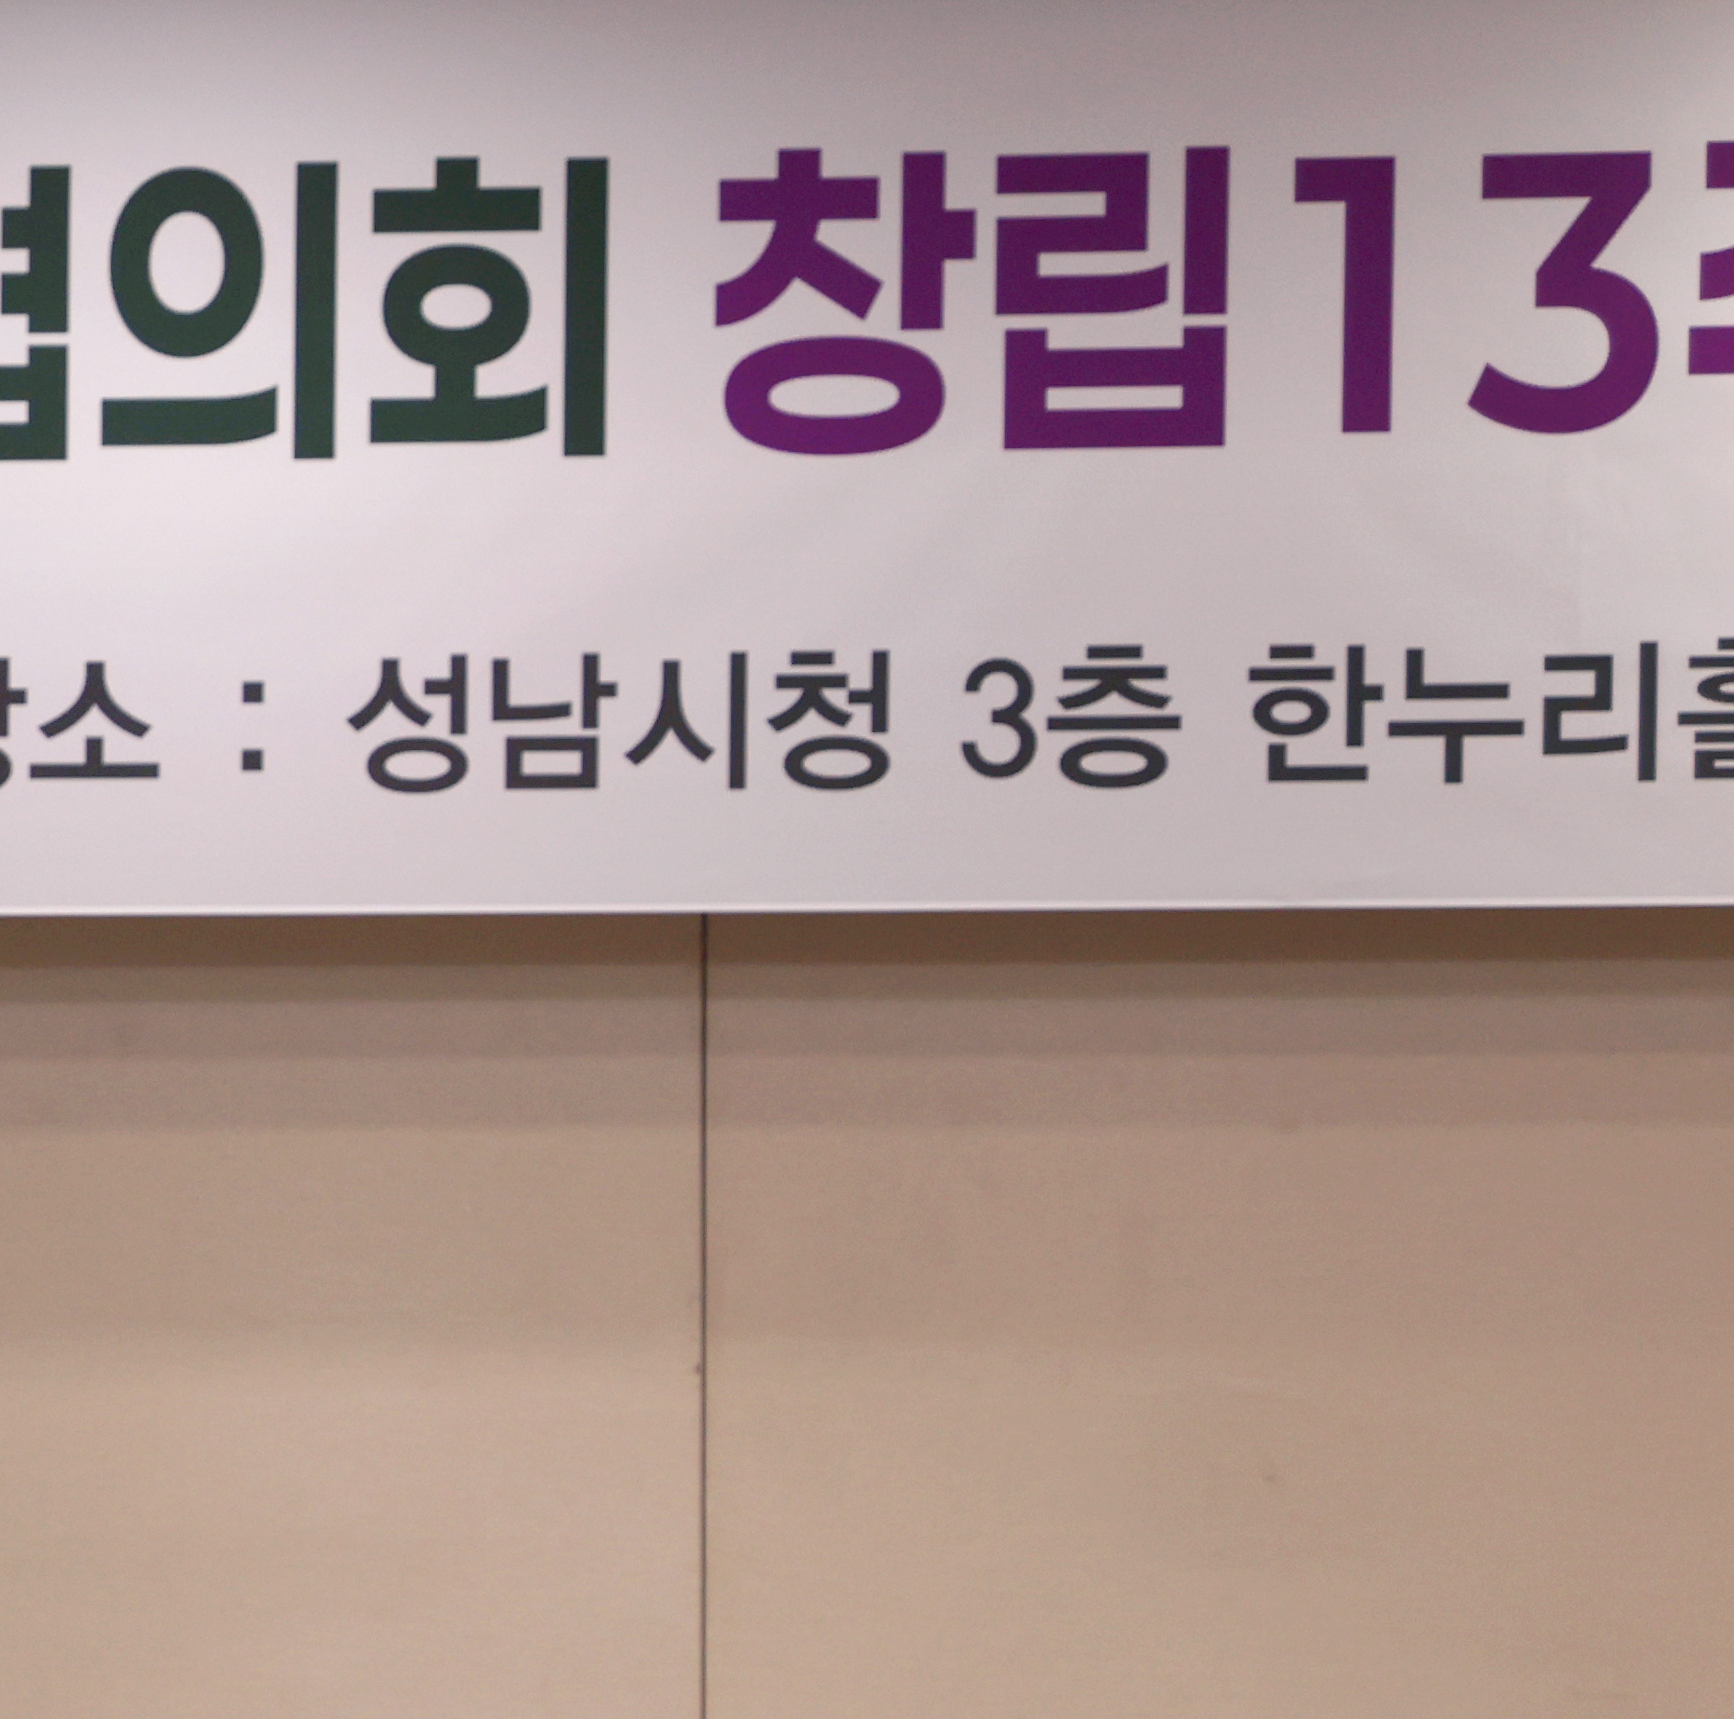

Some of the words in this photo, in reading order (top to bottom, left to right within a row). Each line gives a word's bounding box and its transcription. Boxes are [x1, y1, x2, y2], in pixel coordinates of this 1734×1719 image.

[712, 139, 1734, 457] 창립13
[346, 649, 891, 795] 성남시청
[960, 643, 1183, 790] 3층
